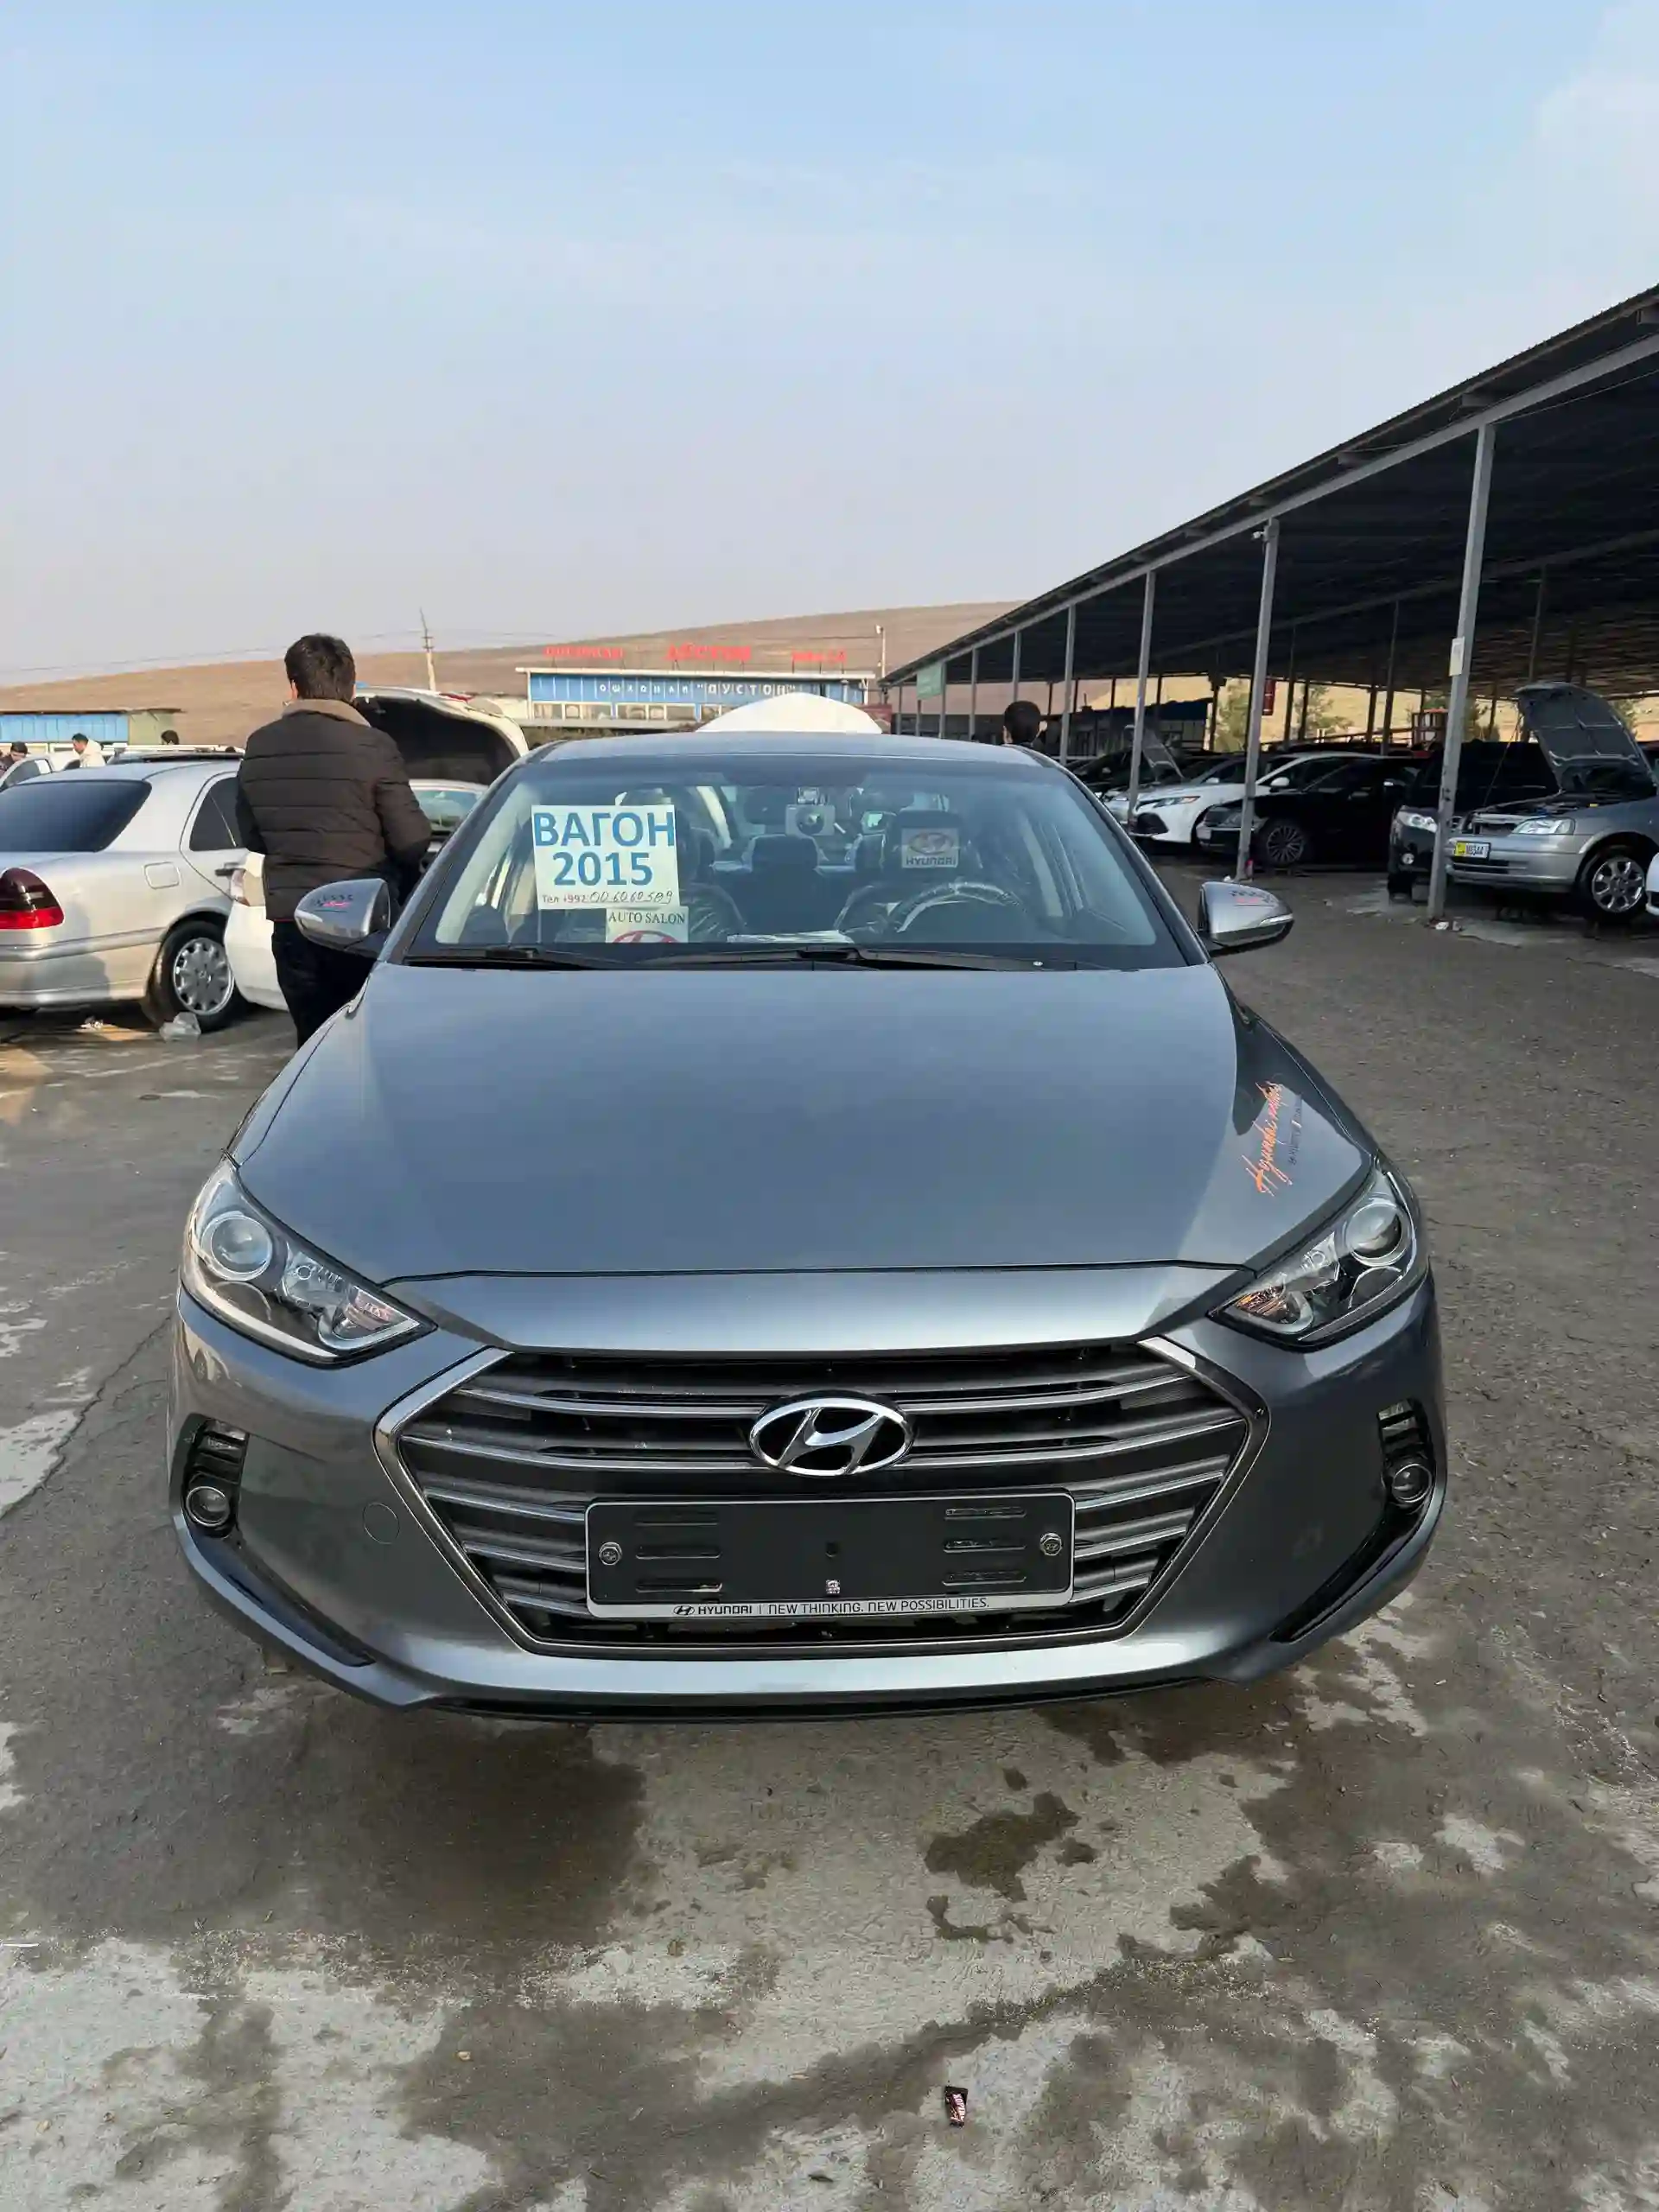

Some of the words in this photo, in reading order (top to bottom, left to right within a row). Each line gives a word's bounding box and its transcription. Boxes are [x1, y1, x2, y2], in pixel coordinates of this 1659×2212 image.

[532, 811, 675, 847] ВАГОН
[552, 851, 653, 887] 2015
[608, 912, 643, 924] AUTO
[645, 912, 686, 925] SALON
[698, 1605, 753, 1616] HYUNDAI
[768, 1604, 798, 1615] NEW
[801, 1602, 864, 1615] THINKING.
[868, 1601, 897, 1612] NEW
[900, 1598, 989, 1611] POSSIBILITIES.
